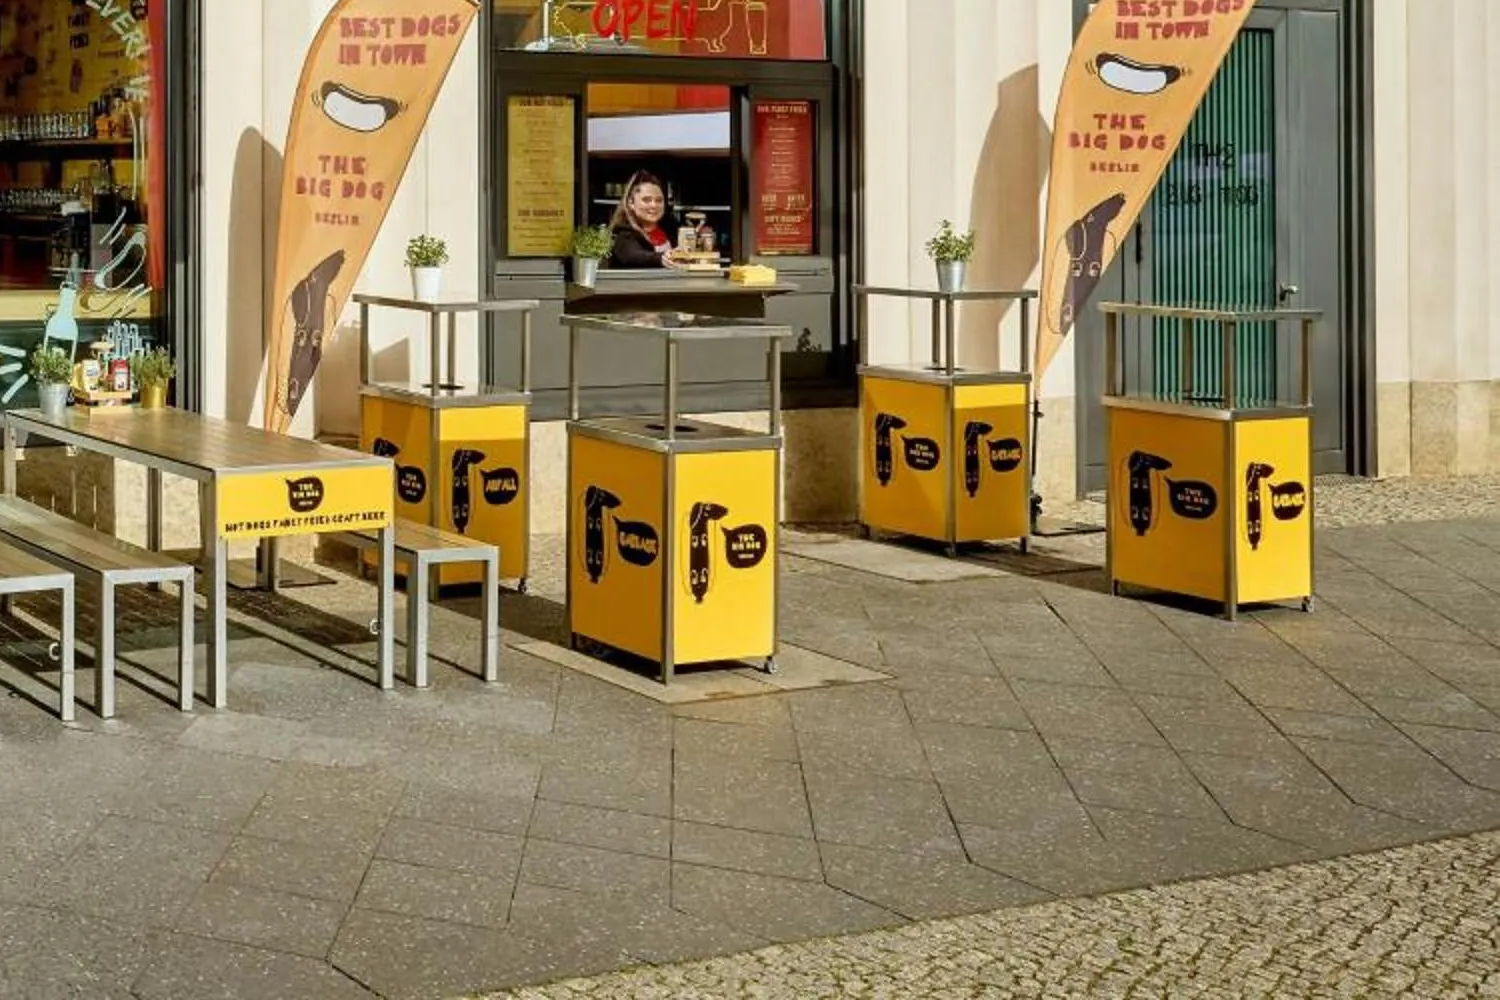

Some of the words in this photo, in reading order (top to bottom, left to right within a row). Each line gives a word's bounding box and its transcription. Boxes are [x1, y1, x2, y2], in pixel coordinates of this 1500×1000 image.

[1116, 0, 1177, 18] BEST
[338, 16, 396, 38] BEST
[401, 13, 462, 38] DOGS
[1115, 21, 1140, 40] IN
[1146, 20, 1210, 40] TOWN
[338, 44, 361, 65] IN
[366, 42, 427, 66] TOWN
[1093, 113, 1147, 131] THE
[1068, 133, 1109, 151] BIG
[1118, 133, 1167, 151] DOG
[317, 154, 367, 175] THE
[295, 177, 331, 199] BIG
[341, 177, 385, 201] DOG
